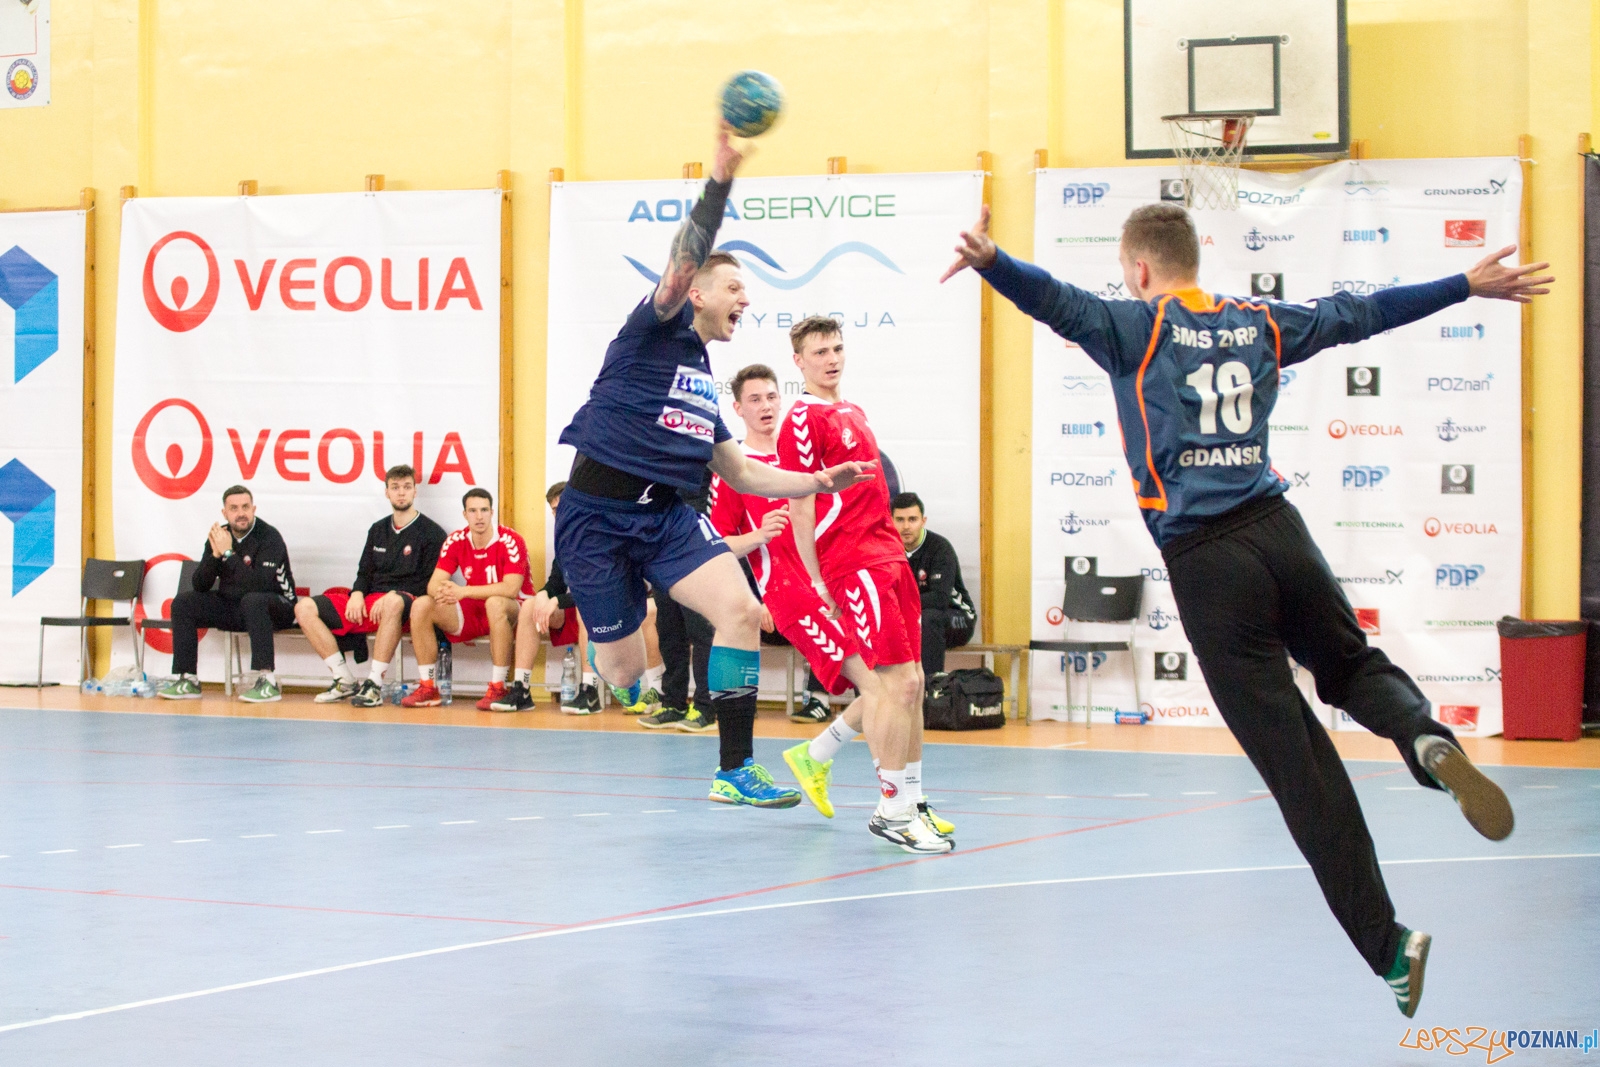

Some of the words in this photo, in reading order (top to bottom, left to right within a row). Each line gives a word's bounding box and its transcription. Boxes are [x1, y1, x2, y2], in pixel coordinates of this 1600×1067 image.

[1063, 184, 1107, 204] PDP
[1424, 188, 1490, 196] GRUNDFOS
[1243, 234, 1295, 242] TRANSKAP
[1343, 230, 1376, 241] ELBUD
[234, 256, 483, 312] VEOLIA
[1172, 324, 1213, 349] SMS
[1441, 326, 1473, 338] ELBUD
[1186, 361, 1253, 434] 16
[1062, 423, 1093, 435] ELBUD
[1350, 424, 1404, 436] VEOLIA
[1436, 425, 1487, 433] TRANSKAP
[226, 428, 476, 485] VEOLIA
[1179, 443, 1263, 467] GDAŃSK
[1343, 467, 1386, 487] PDP
[1059, 518, 1110, 526] TRANSKAP
[1444, 522, 1498, 534] VEOLIA
[1436, 566, 1482, 586] PDP
[1157, 706, 1210, 718] VEOLIA
